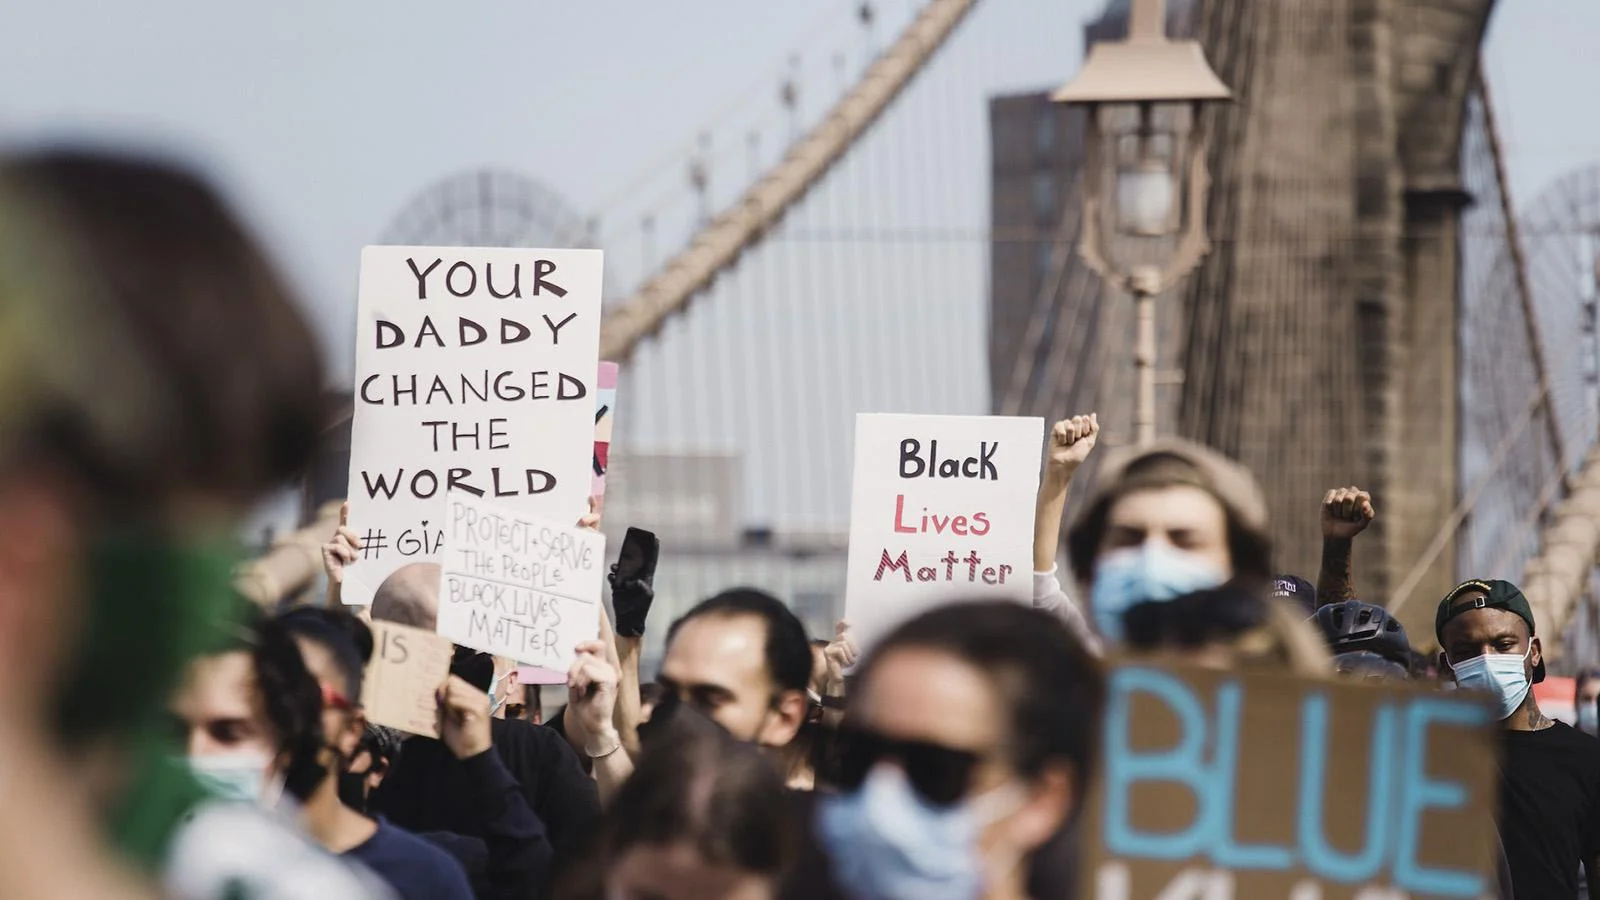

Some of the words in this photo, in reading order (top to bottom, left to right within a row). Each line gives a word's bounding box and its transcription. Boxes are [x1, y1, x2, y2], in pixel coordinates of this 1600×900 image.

[406, 258, 568, 299] YOUR
[376, 312, 577, 349] DADDY
[360, 370, 586, 406] CHANGED
[422, 418, 510, 452] THE
[361, 467, 557, 500] WORLD
[894, 494, 991, 536] Lives
[453, 502, 534, 554] PROTECT
[539, 527, 592, 571] SERVE
[457, 549, 495, 575] THE
[503, 555, 564, 588] PEOPLE
[873, 548, 1013, 584] Matter
[448, 578, 506, 613] BLACK
[381, 630, 408, 664] IS
[469, 610, 561, 658] MATTER
[1103, 666, 1489, 896] BLUE
